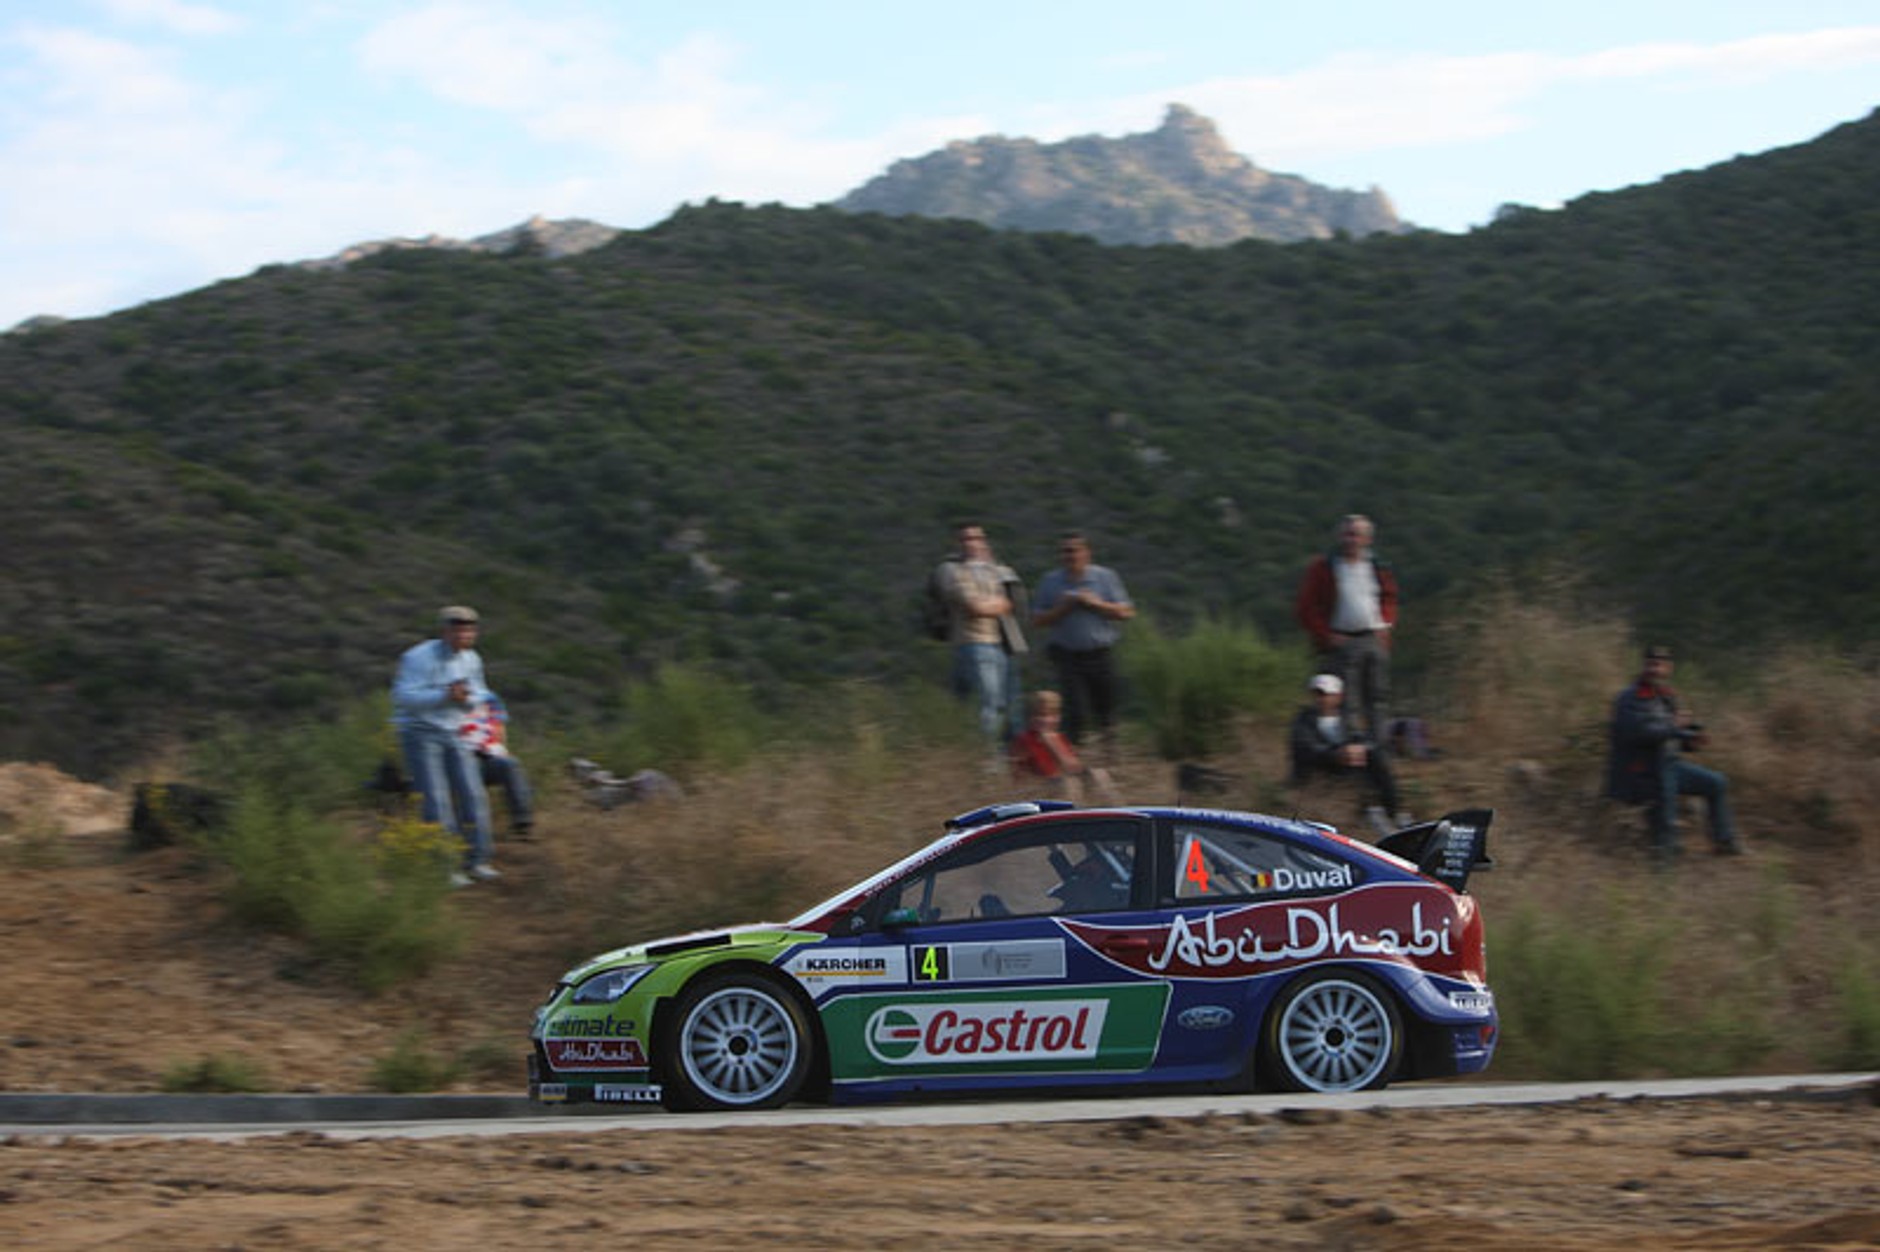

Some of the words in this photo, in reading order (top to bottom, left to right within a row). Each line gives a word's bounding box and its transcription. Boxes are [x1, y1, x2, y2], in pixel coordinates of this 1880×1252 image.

[1183, 839, 1209, 893] 4
[1273, 864, 1354, 892] Duval
[1284, 902, 1455, 962] Dhabi
[920, 946, 939, 981] 4
[925, 1007, 1089, 1056] Castrol
